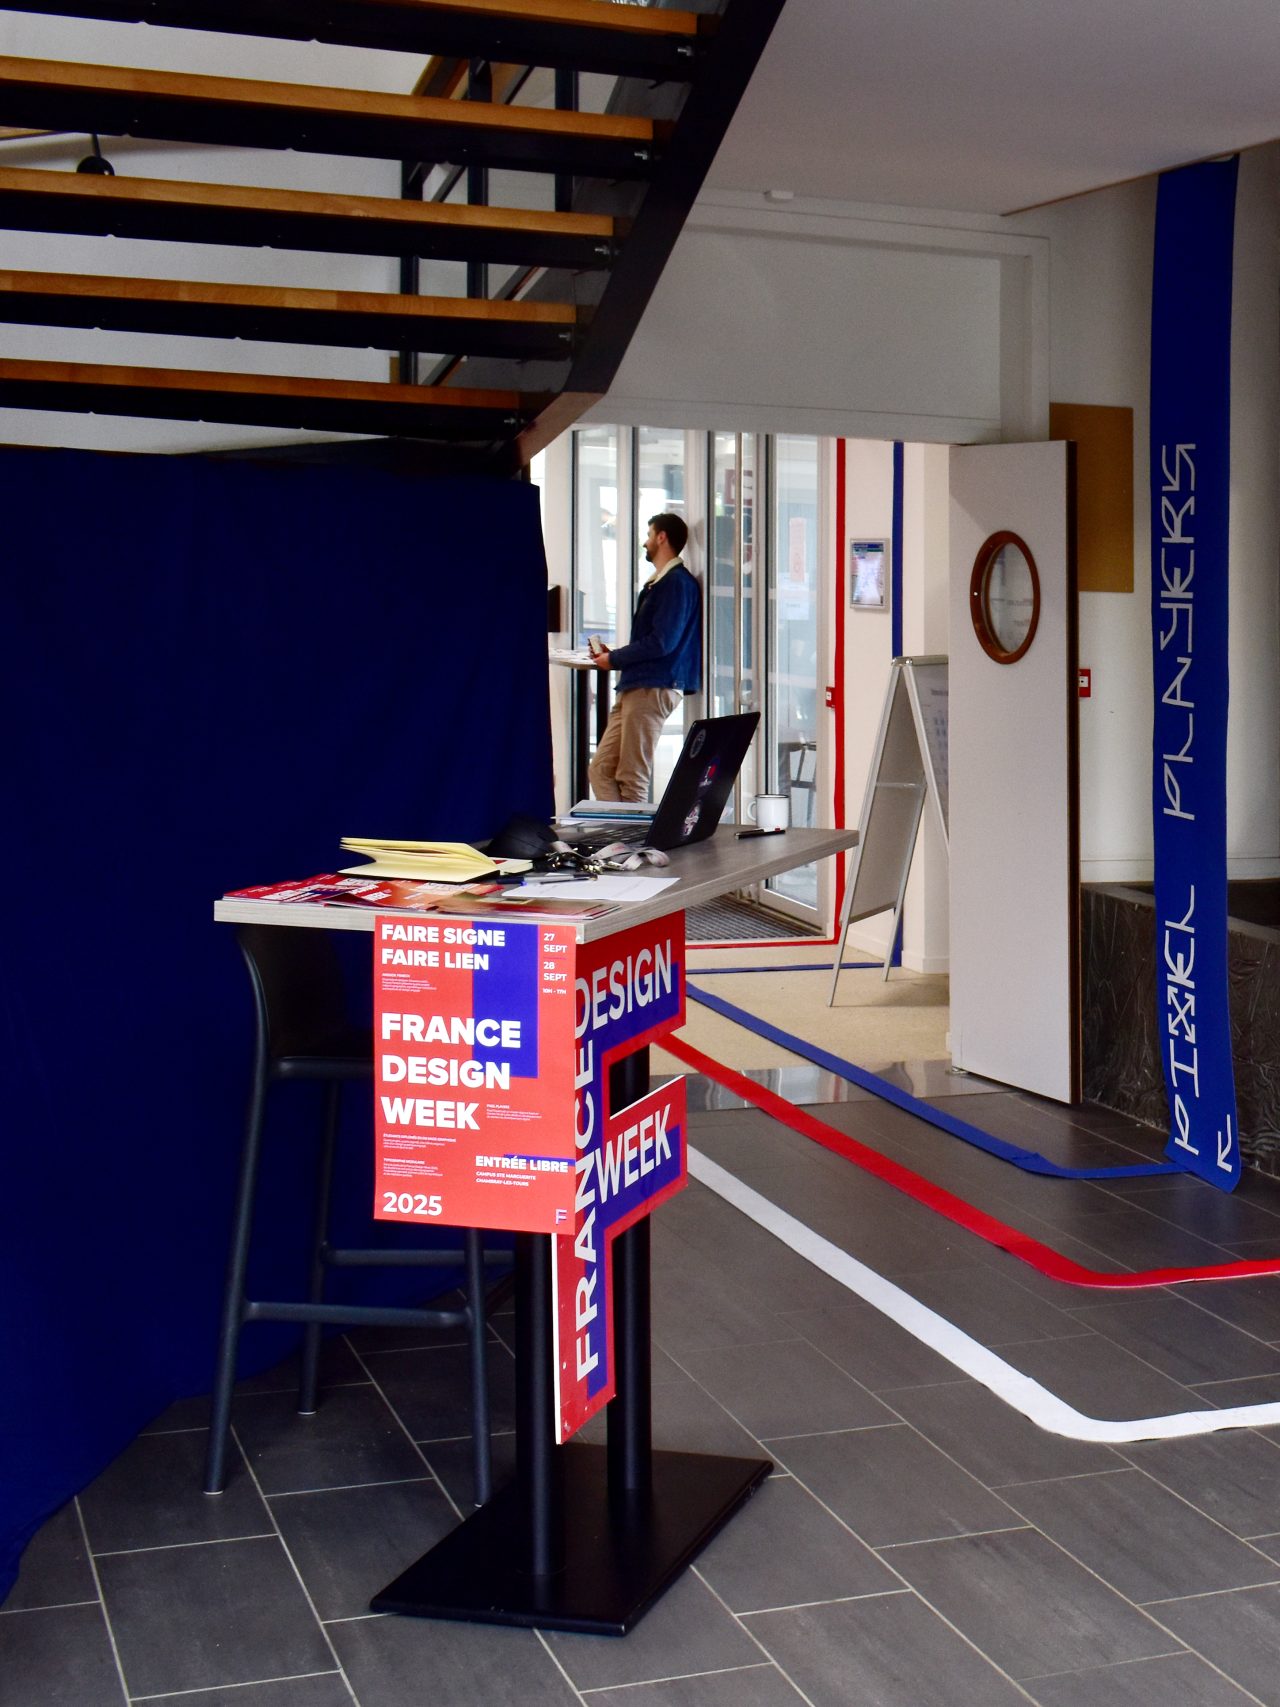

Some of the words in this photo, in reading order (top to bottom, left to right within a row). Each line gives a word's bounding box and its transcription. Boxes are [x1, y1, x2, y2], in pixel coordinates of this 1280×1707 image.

[1160, 443, 1198, 821] PLAYERS
[381, 923, 439, 943] FAIRE
[443, 927, 506, 947] SIGNE
[543, 932, 555, 941] 27
[381, 948, 439, 968] FAIRE
[444, 952, 489, 971] LIEN
[543, 944, 567, 953] SEPT
[543, 961, 555, 970] 28
[543, 973, 567, 982] SEPT
[575, 938, 672, 1041] DESIGN
[381, 1012, 521, 1049] FRANCE
[1164, 884, 1201, 1156] PIXEL
[381, 1054, 511, 1090] DESIGN
[380, 1096, 481, 1130] WEEK
[475, 1155, 527, 1170] ENTRÉE
[529, 1160, 569, 1173] LIBRE
[593, 1103, 673, 1205] WEEK
[475, 1170, 496, 1178] CAMPUS
[505, 1172, 536, 1181] MARGUERITE
[382, 1191, 443, 1217] 2025
[555, 1208, 568, 1225] F
[574, 1039, 599, 1382] FRANCE
